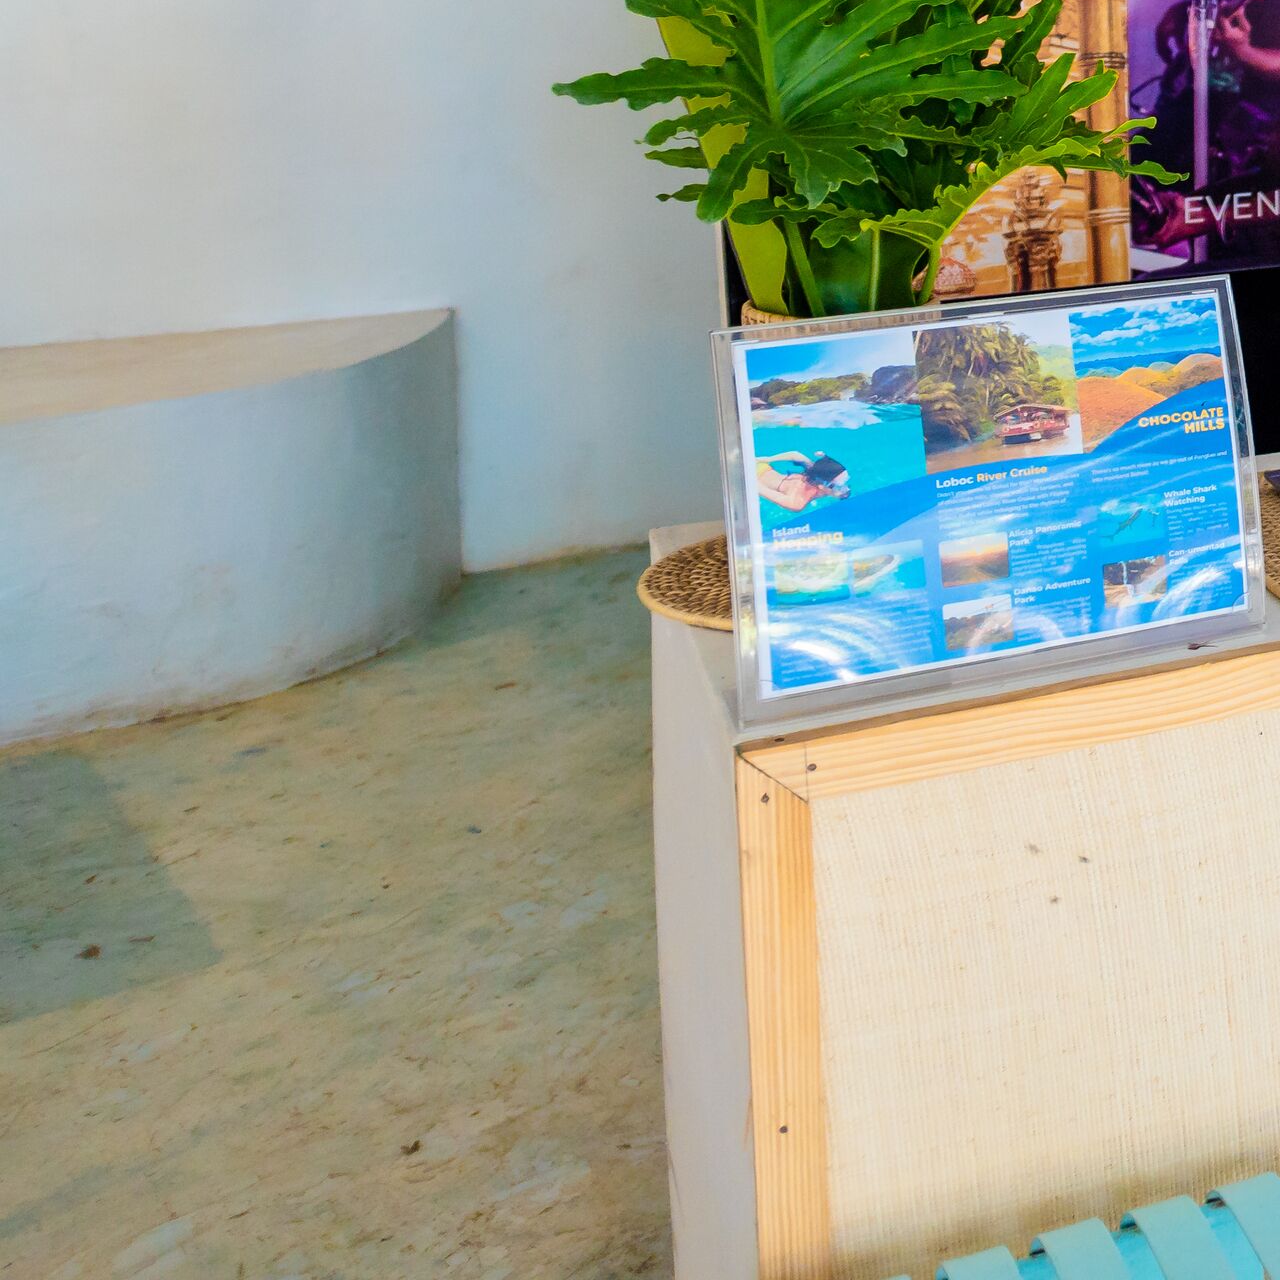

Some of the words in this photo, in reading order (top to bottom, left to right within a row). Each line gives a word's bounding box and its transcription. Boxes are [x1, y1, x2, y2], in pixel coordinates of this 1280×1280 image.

[1138, 407, 1224, 428] CHOCOLATE
[936, 475, 974, 489] Loboc
[976, 470, 1007, 483] River
[1010, 465, 1048, 478] Cruise
[1164, 489, 1191, 498] Whale
[1193, 484, 1217, 494] Shark
[1164, 496, 1206, 507] Watching
[772, 524, 810, 537] Island
[1009, 528, 1033, 538] Alicia
[1036, 521, 1082, 534] Panoramic
[774, 531, 843, 550] Hopping
[1010, 538, 1031, 546] Park
[1014, 584, 1043, 595] Danao
[1045, 577, 1091, 591] Adventure
[1014, 595, 1036, 604] Park
